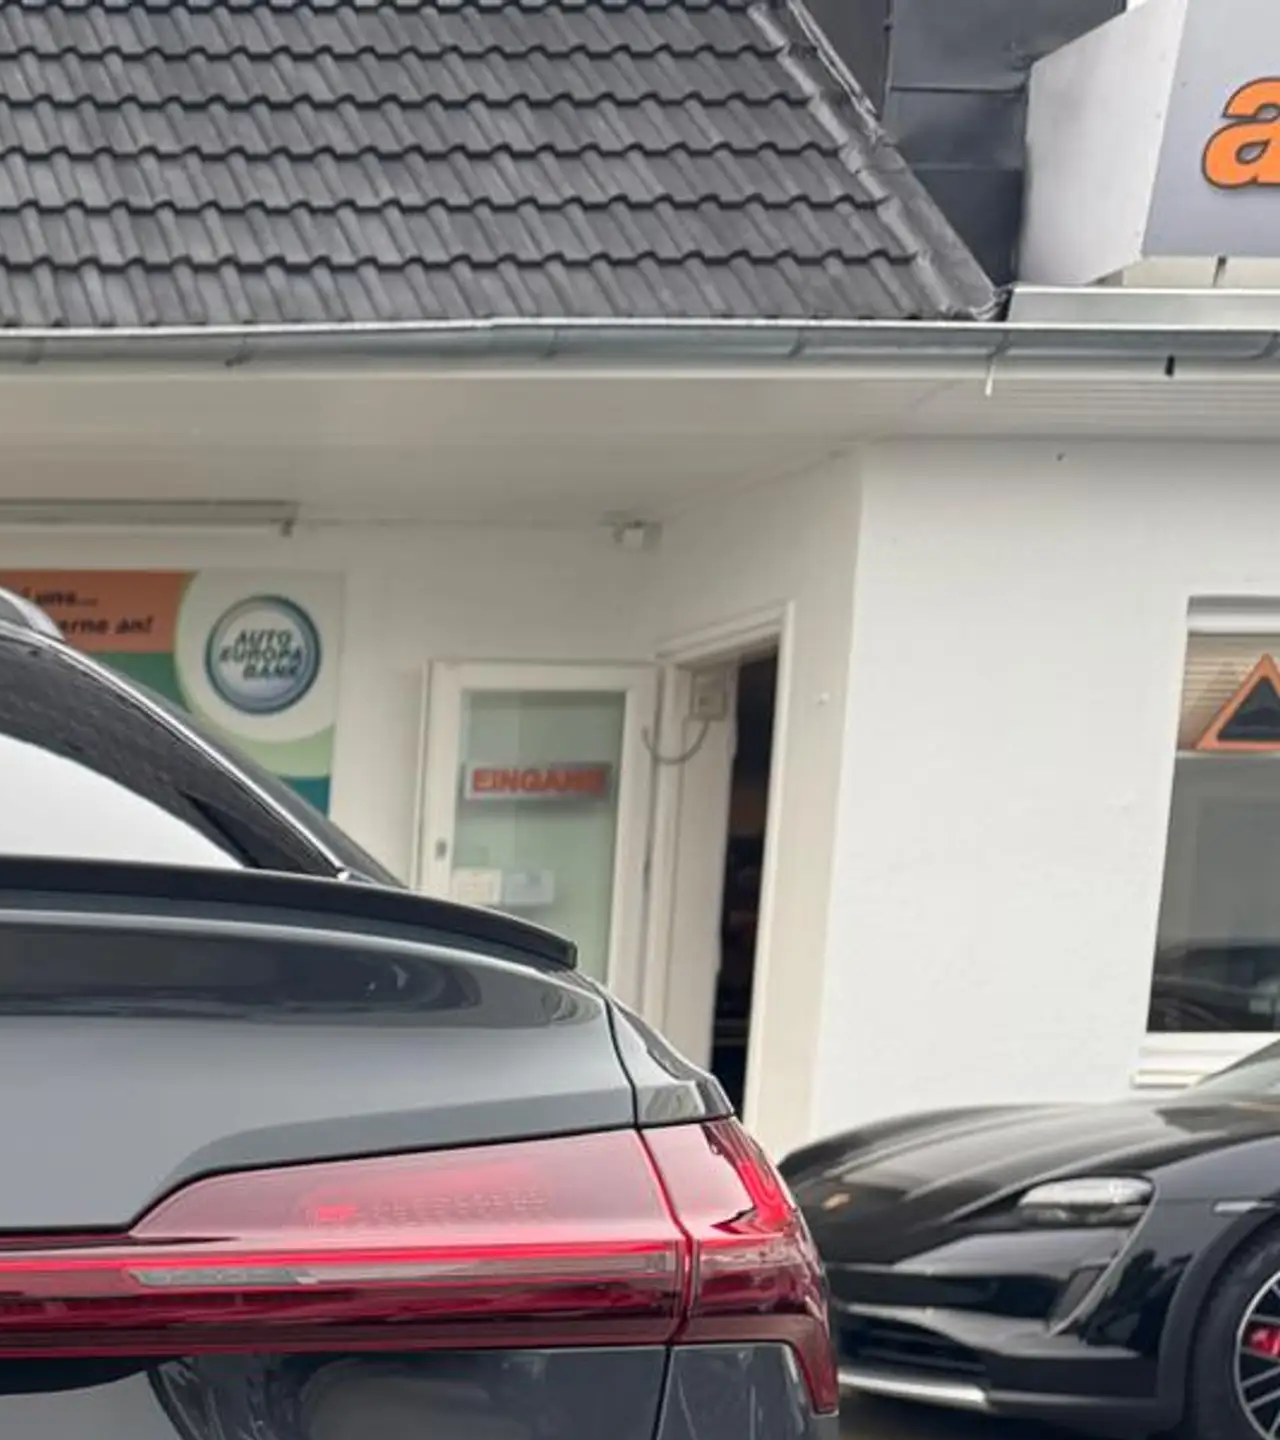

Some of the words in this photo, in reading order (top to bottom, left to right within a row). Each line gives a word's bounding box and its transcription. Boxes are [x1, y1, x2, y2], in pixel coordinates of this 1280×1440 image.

[233, 628, 293, 646] AUTO
[219, 644, 303, 663] EUROPA
[243, 663, 299, 680] BANK
